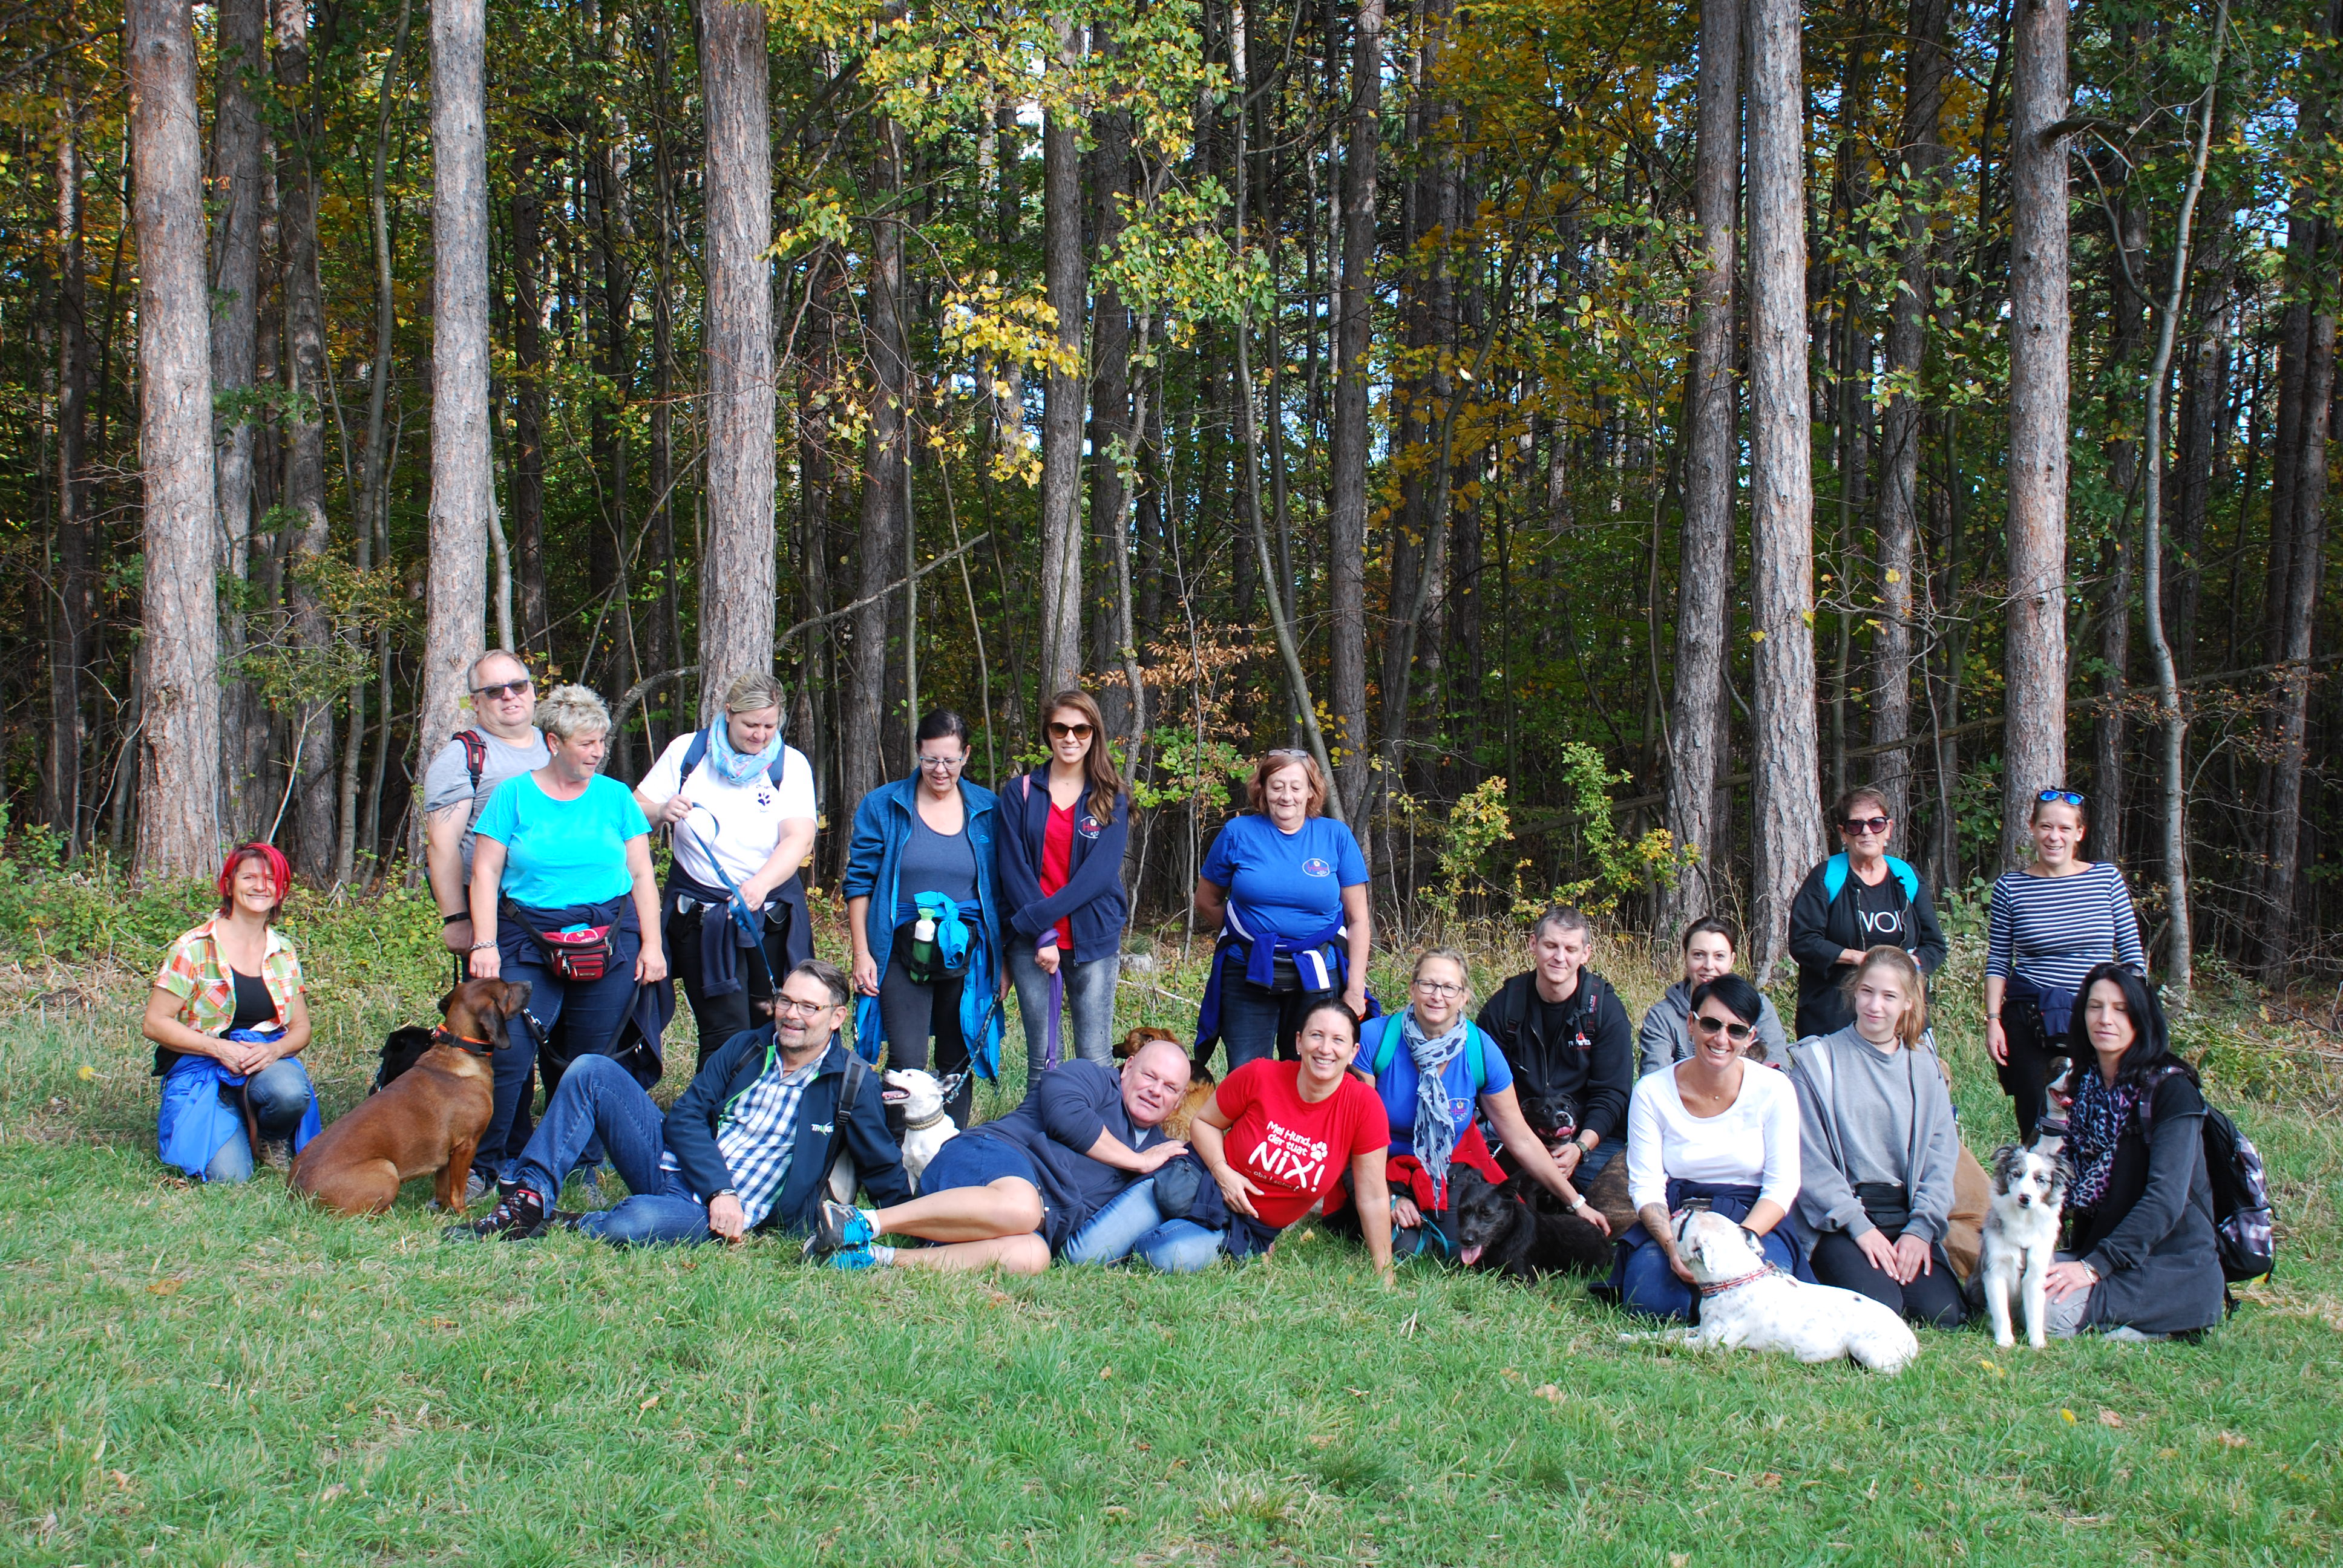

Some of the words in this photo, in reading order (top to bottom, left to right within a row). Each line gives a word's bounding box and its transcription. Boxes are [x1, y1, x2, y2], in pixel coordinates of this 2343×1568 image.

[1858, 910, 1902, 933] VOI
[1267, 1134, 1285, 1146] der
[1286, 1142, 1308, 1156] tuat
[1283, 1129, 1311, 1148] Hund,
